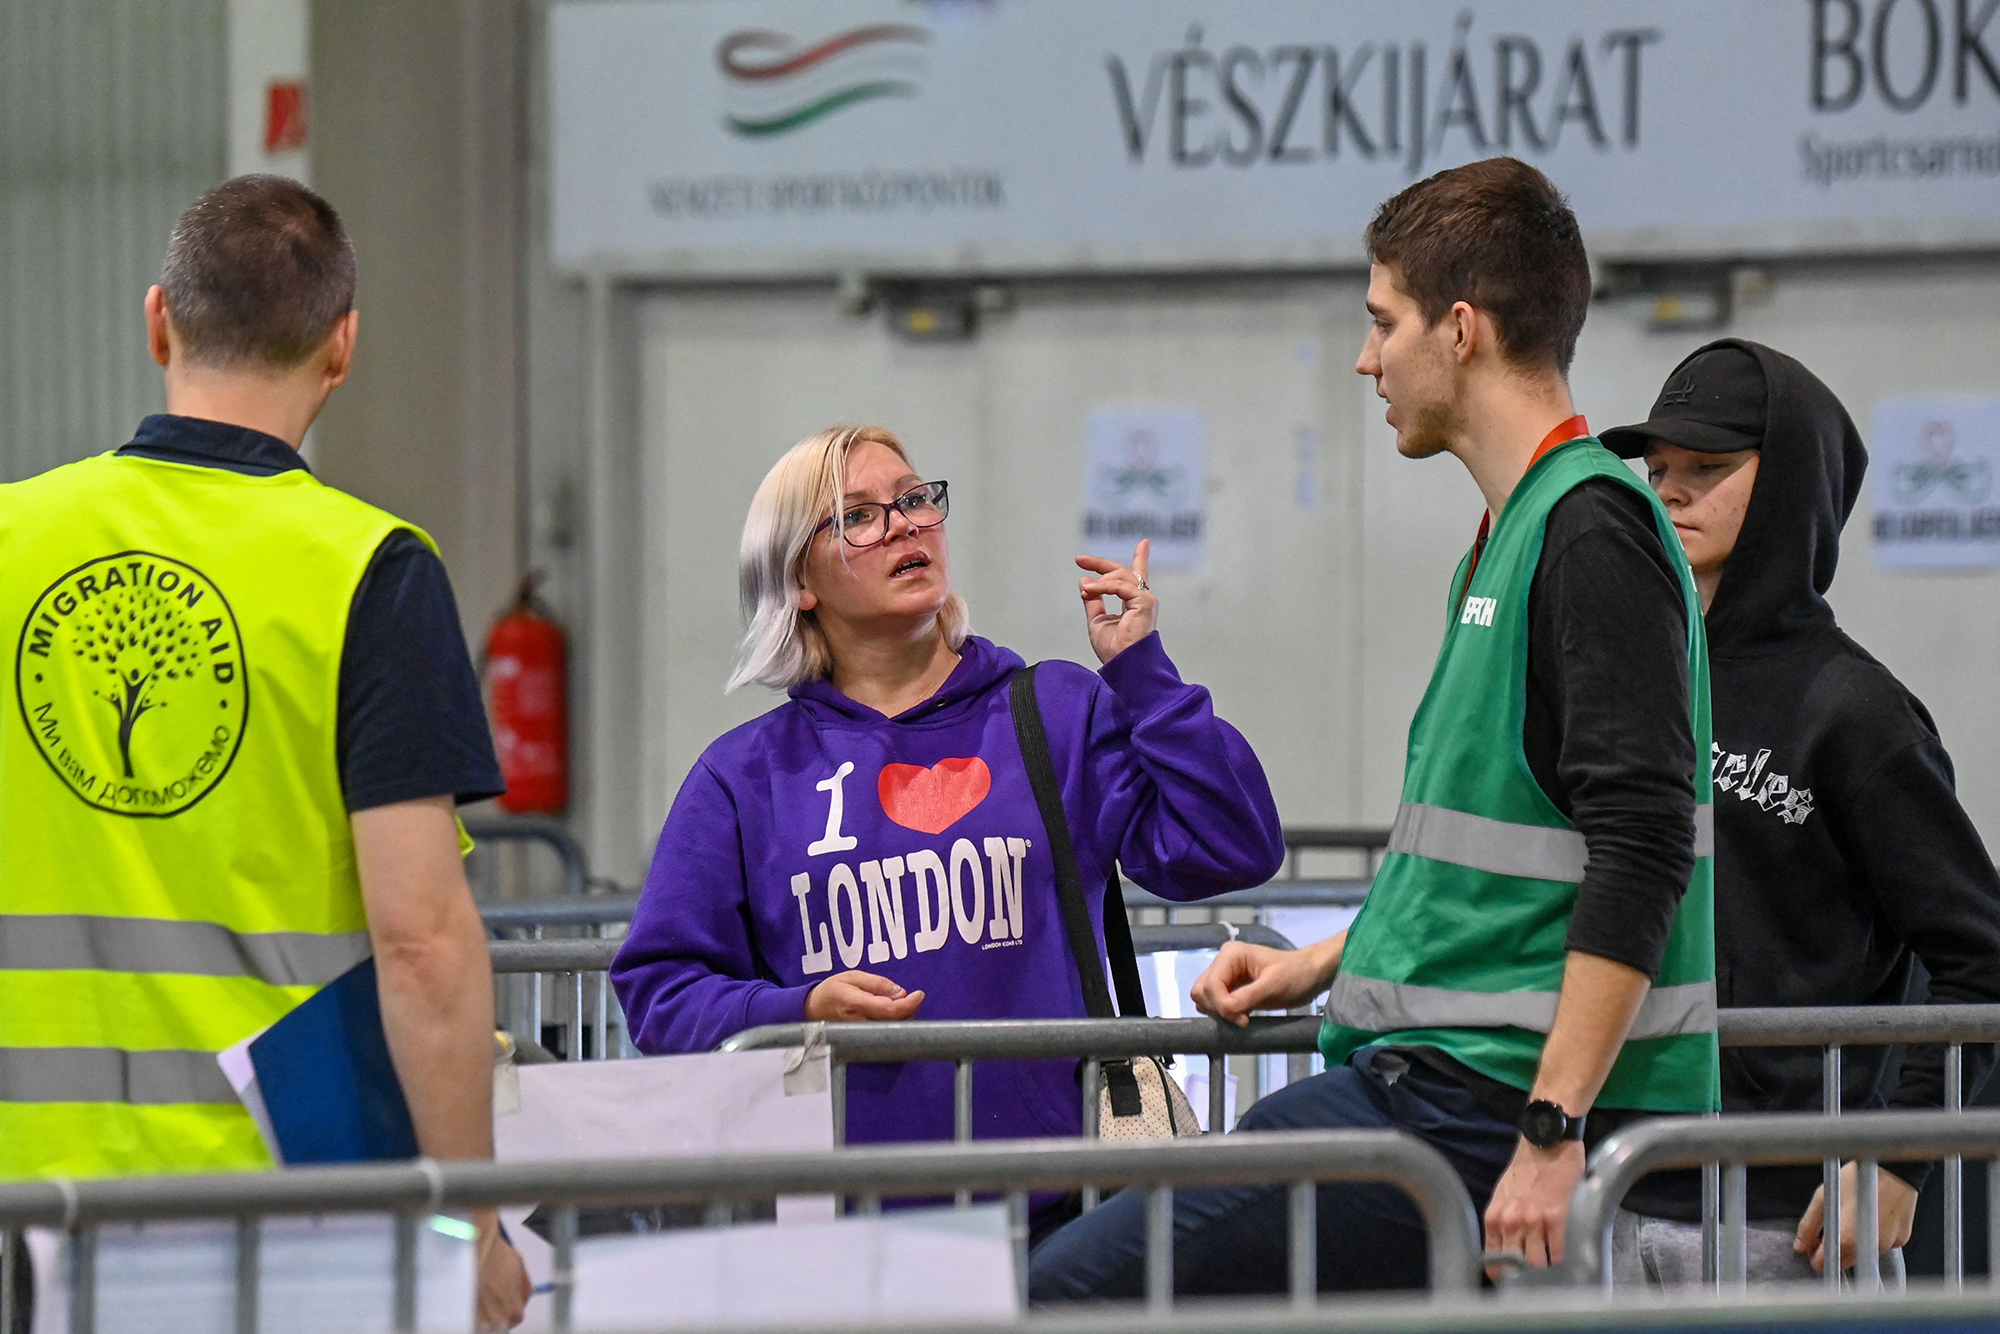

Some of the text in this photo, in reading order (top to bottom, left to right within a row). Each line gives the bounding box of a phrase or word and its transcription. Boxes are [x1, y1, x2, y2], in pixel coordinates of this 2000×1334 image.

[1106, 11, 1662, 174] VÉSZKIJÁRAT
[28, 562, 235, 684] MIGRATION AID
[807, 761, 858, 857] I
[790, 836, 1027, 975] LONDON
[981, 941, 1001, 950] LONDON
